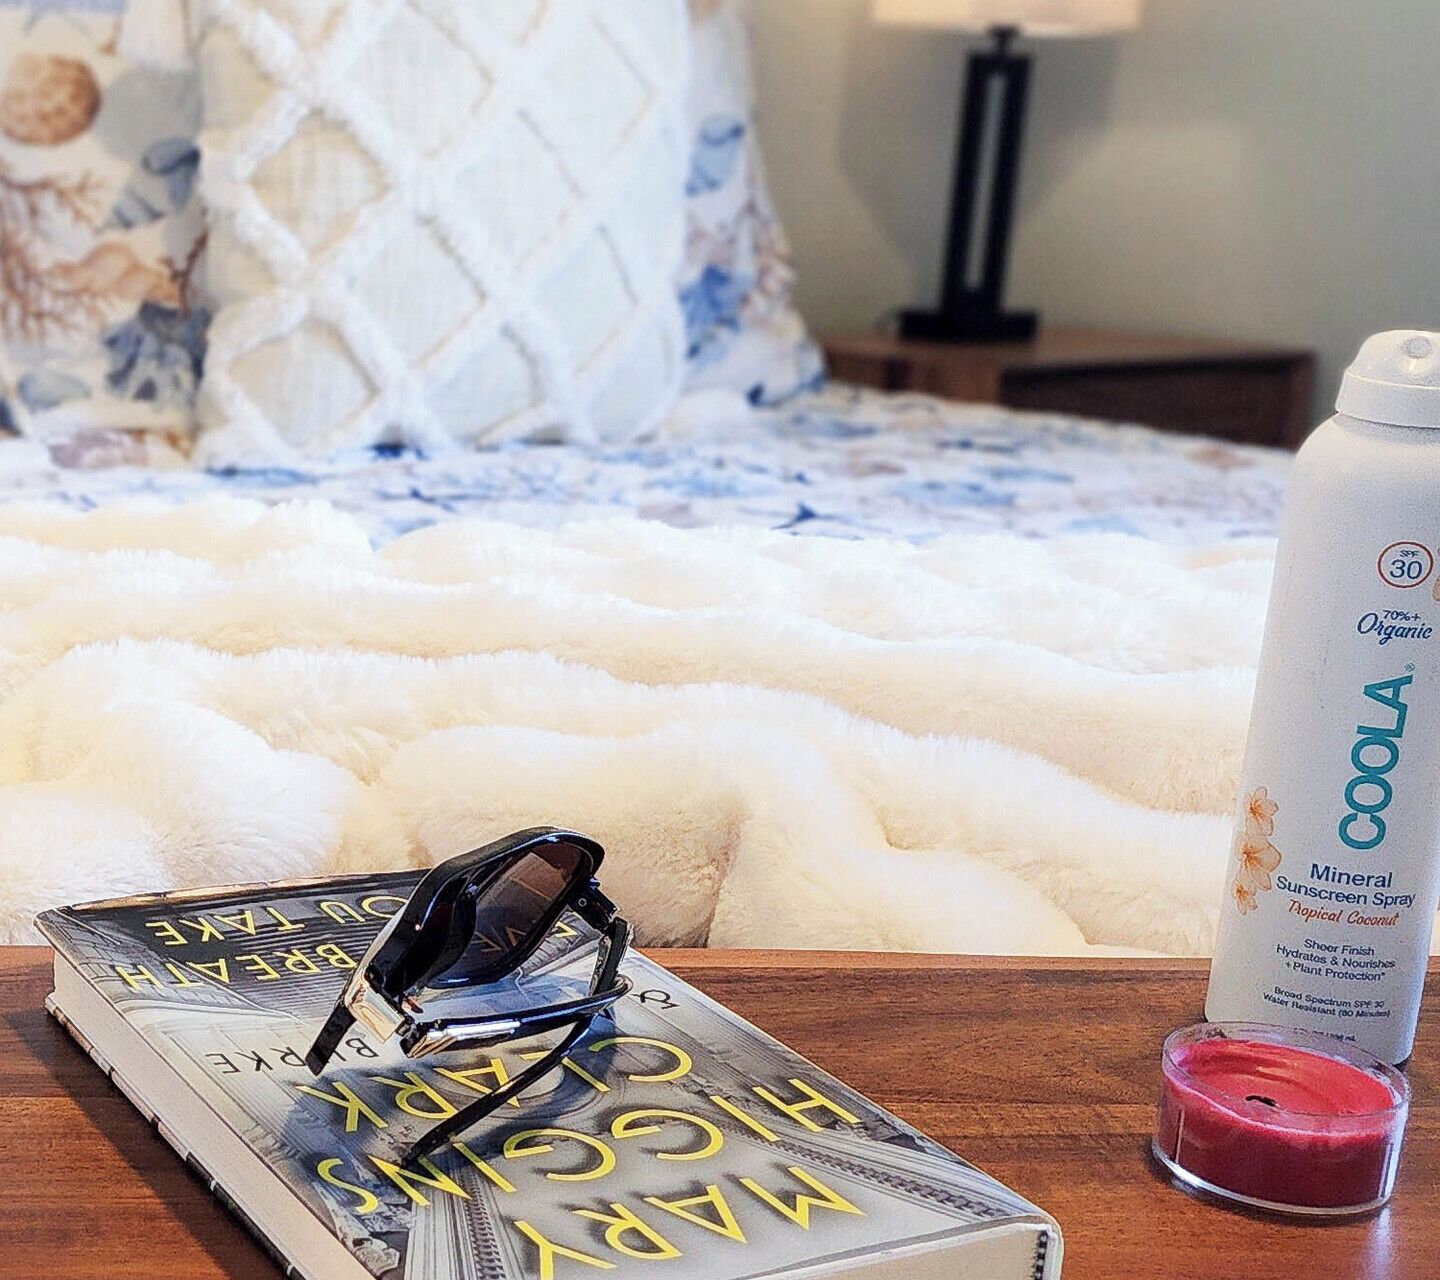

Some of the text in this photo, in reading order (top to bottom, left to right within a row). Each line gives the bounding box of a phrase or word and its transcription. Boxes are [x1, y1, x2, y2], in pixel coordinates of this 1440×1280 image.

[1399, 549, 1419, 558] SPF
[1389, 559, 1423, 580] 30
[1357, 612, 1434, 646] Organic
[1383, 609, 1421, 622] 70%+
[1338, 673, 1413, 850] COOLA
[1310, 863, 1393, 888] Mineral
[1276, 875, 1416, 909] Sunscreen Spray
[144, 894, 412, 947] OU TAKE
[1288, 899, 1400, 927] Tropical Coconut
[1276, 943, 1396, 969] Hydrates & Nourishes
[1304, 938, 1375, 956] Sheer Finish
[115, 943, 359, 991] BREATH
[1263, 992, 1289, 1007] Water
[1291, 1001, 1336, 1016] Resistant
[1274, 986, 1303, 1000] Broad
[1305, 993, 1351, 1008] Spectrum
[296, 1036, 693, 1133] CLARK
[316, 1078, 864, 1214] HIGGINS
